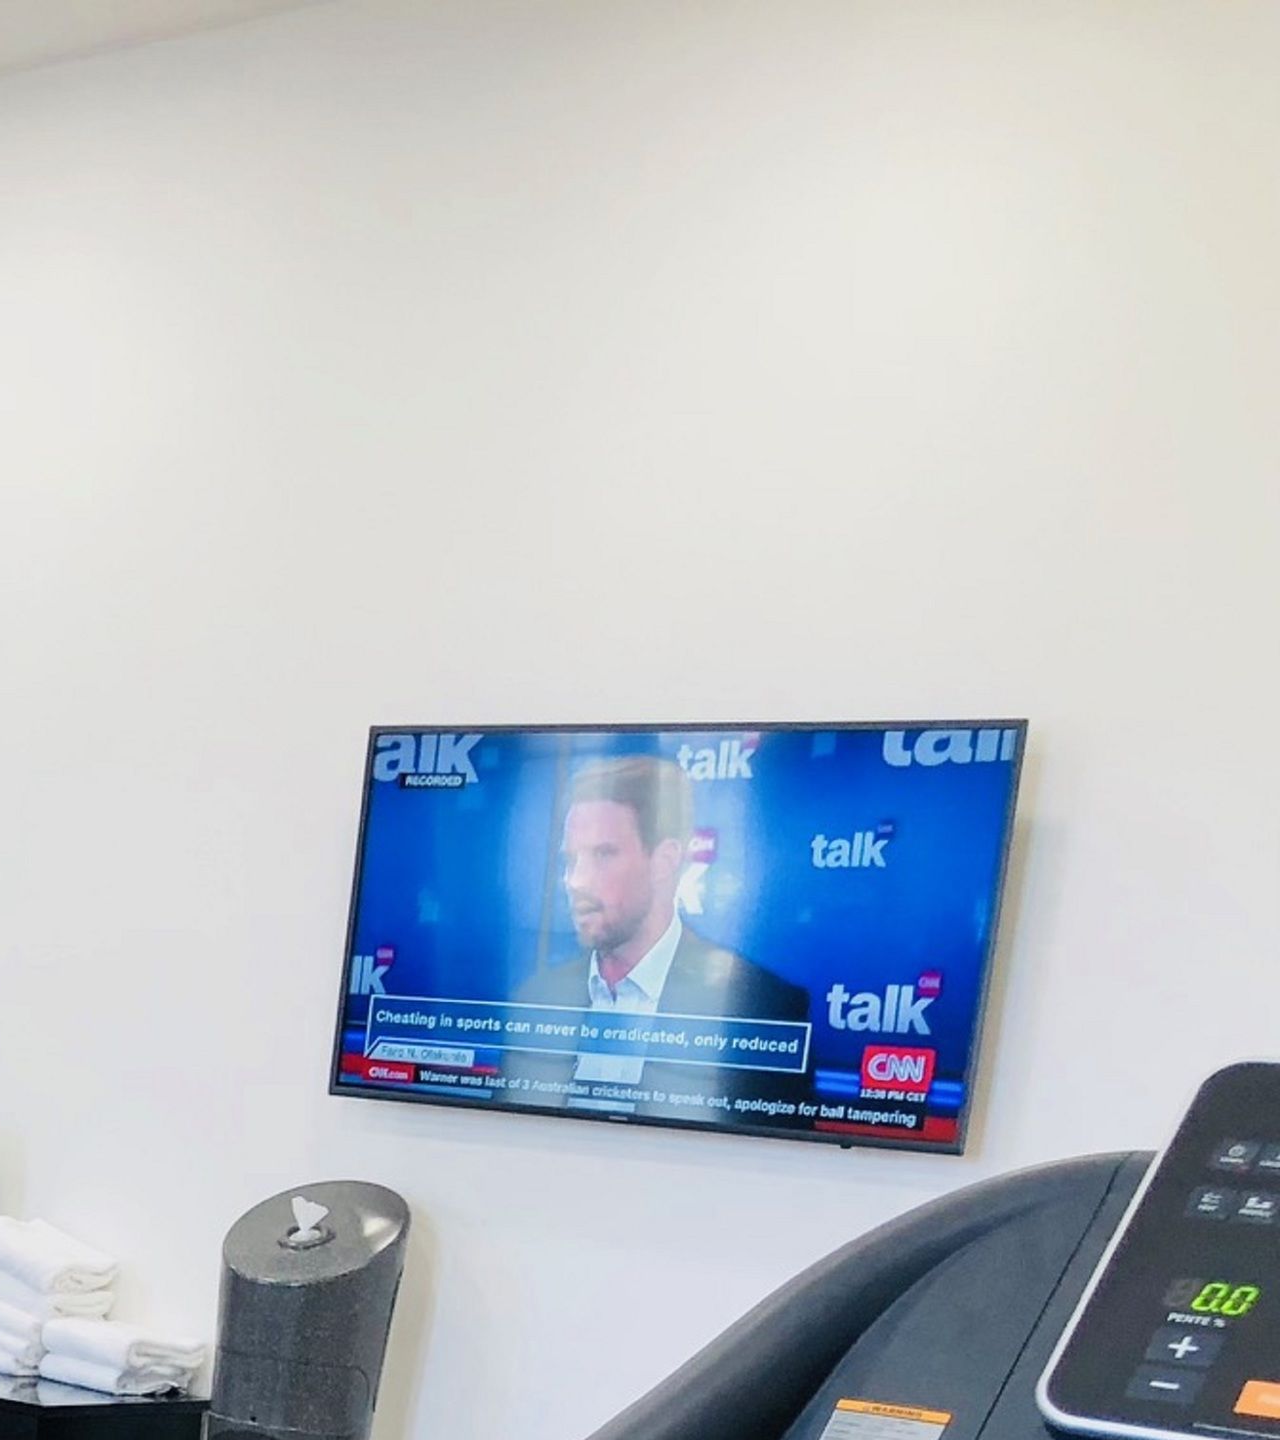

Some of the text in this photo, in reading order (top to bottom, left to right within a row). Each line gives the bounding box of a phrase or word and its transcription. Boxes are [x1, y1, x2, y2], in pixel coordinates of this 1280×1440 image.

[676, 739, 757, 782] talk
[405, 774, 463, 788] RECORDED
[811, 831, 889, 869] talk
[826, 983, 936, 1036] talk
[376, 1009, 799, 1054] Cheating in sports can never be eradicated, only reduced
[867, 1053, 926, 1083] CNN
[420, 1069, 458, 1084] Warner
[460, 1075, 482, 1086] was
[484, 1075, 507, 1089] last
[508, 1078, 521, 1090] of
[522, 1079, 530, 1090] 3
[531, 1080, 589, 1096] Australian
[591, 1085, 650, 1102] cricketers
[653, 1090, 665, 1102] to
[669, 1092, 704, 1107] speak
[734, 1098, 796, 1117] apologize
[798, 1102, 818, 1117] for
[820, 1104, 844, 1119] ball
[847, 1105, 917, 1129] tampering
[887, 1090, 905, 1100] PM
